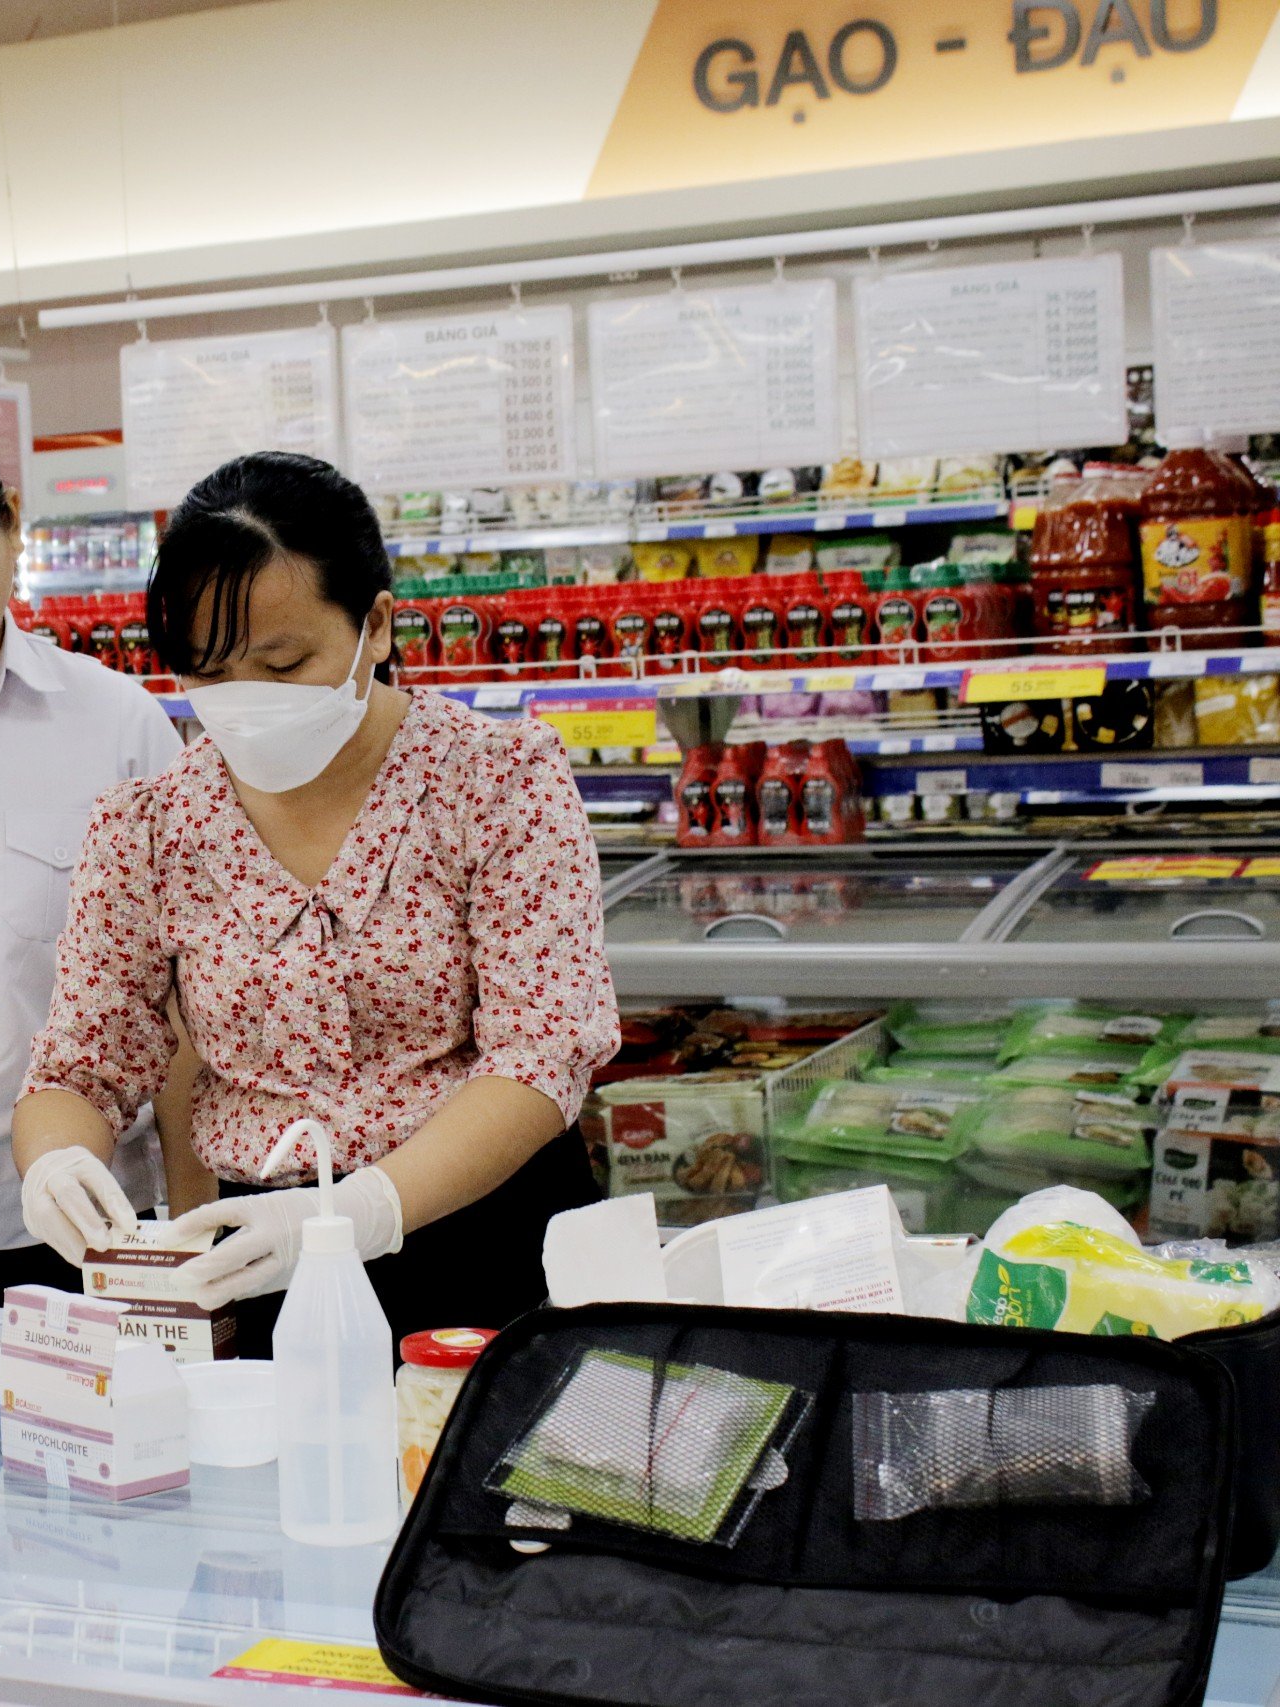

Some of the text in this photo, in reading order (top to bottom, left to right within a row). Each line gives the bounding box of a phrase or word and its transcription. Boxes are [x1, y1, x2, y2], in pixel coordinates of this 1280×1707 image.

[692, 18, 898, 124] GẠO
[472, 321, 498, 340] GIÁ
[573, 724, 592, 740] 55
[24, 1330, 92, 1355] HYPOCHLORITE
[153, 1324, 189, 1341] THE
[21, 1430, 89, 1458] HYPOCHLORITE
